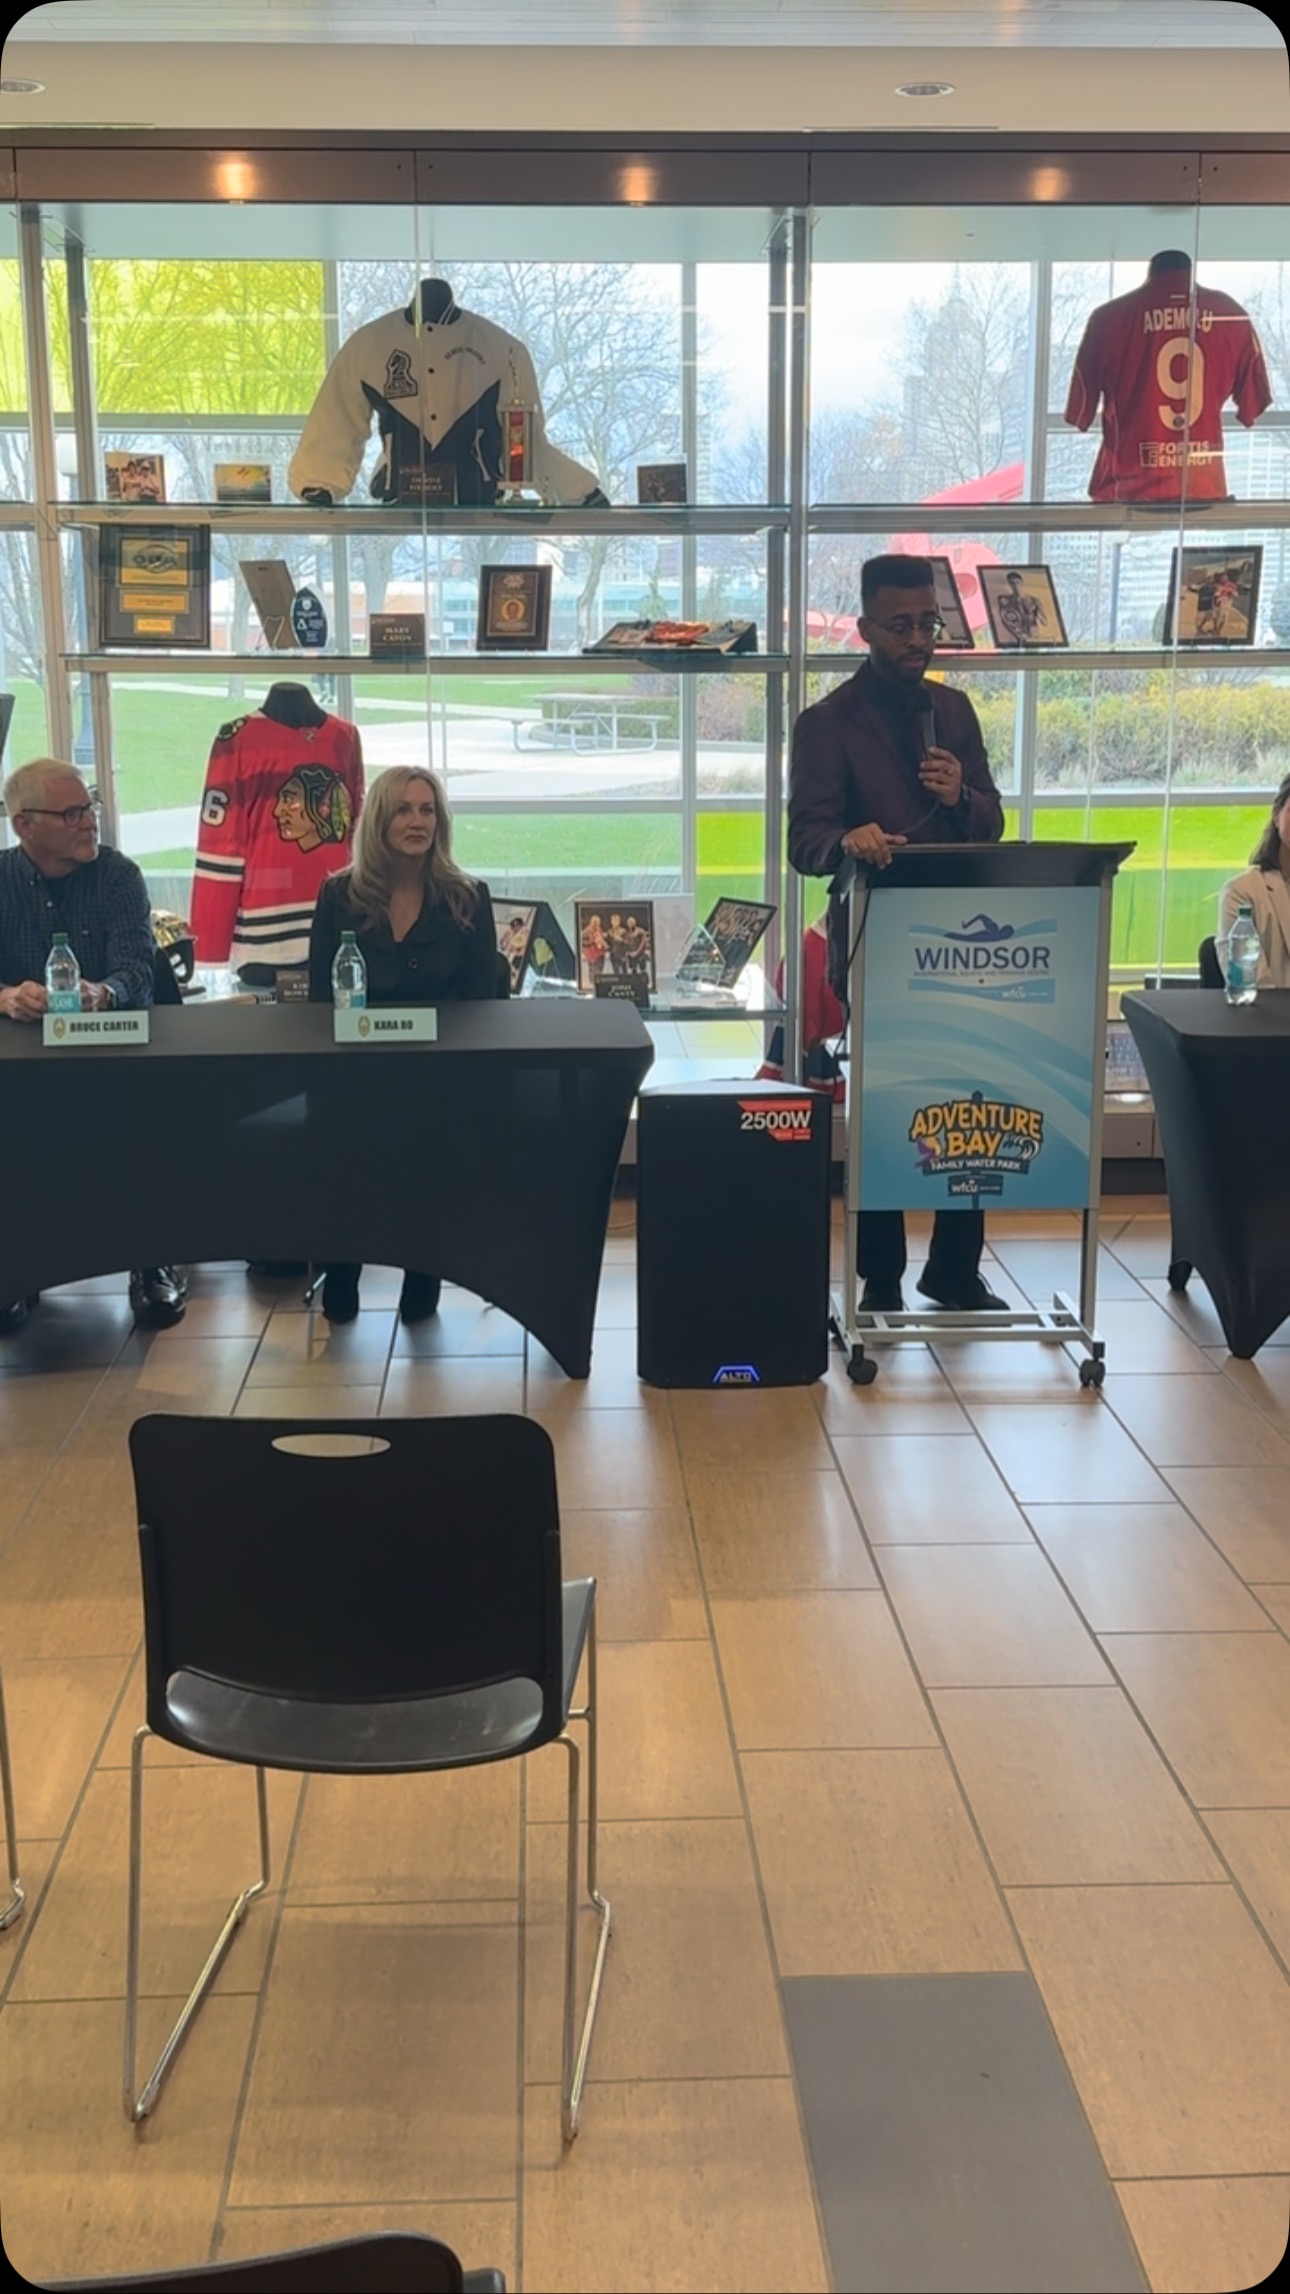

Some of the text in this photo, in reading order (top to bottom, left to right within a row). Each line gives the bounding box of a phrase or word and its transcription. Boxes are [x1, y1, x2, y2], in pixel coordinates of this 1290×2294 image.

[1157, 337, 1205, 431] 9
[202, 788, 228, 826] 6
[914, 946, 1051, 970] WINDSOR
[70, 1021, 139, 1032] BRUCE CARTER
[374, 1020, 413, 1031] KARA RO
[740, 1110, 812, 1130] 2500W
[911, 1101, 1042, 1140] ADVENTURE
[947, 1130, 1002, 1157] BAY
[931, 1159, 1020, 1171] FAMILY WATER PARK
